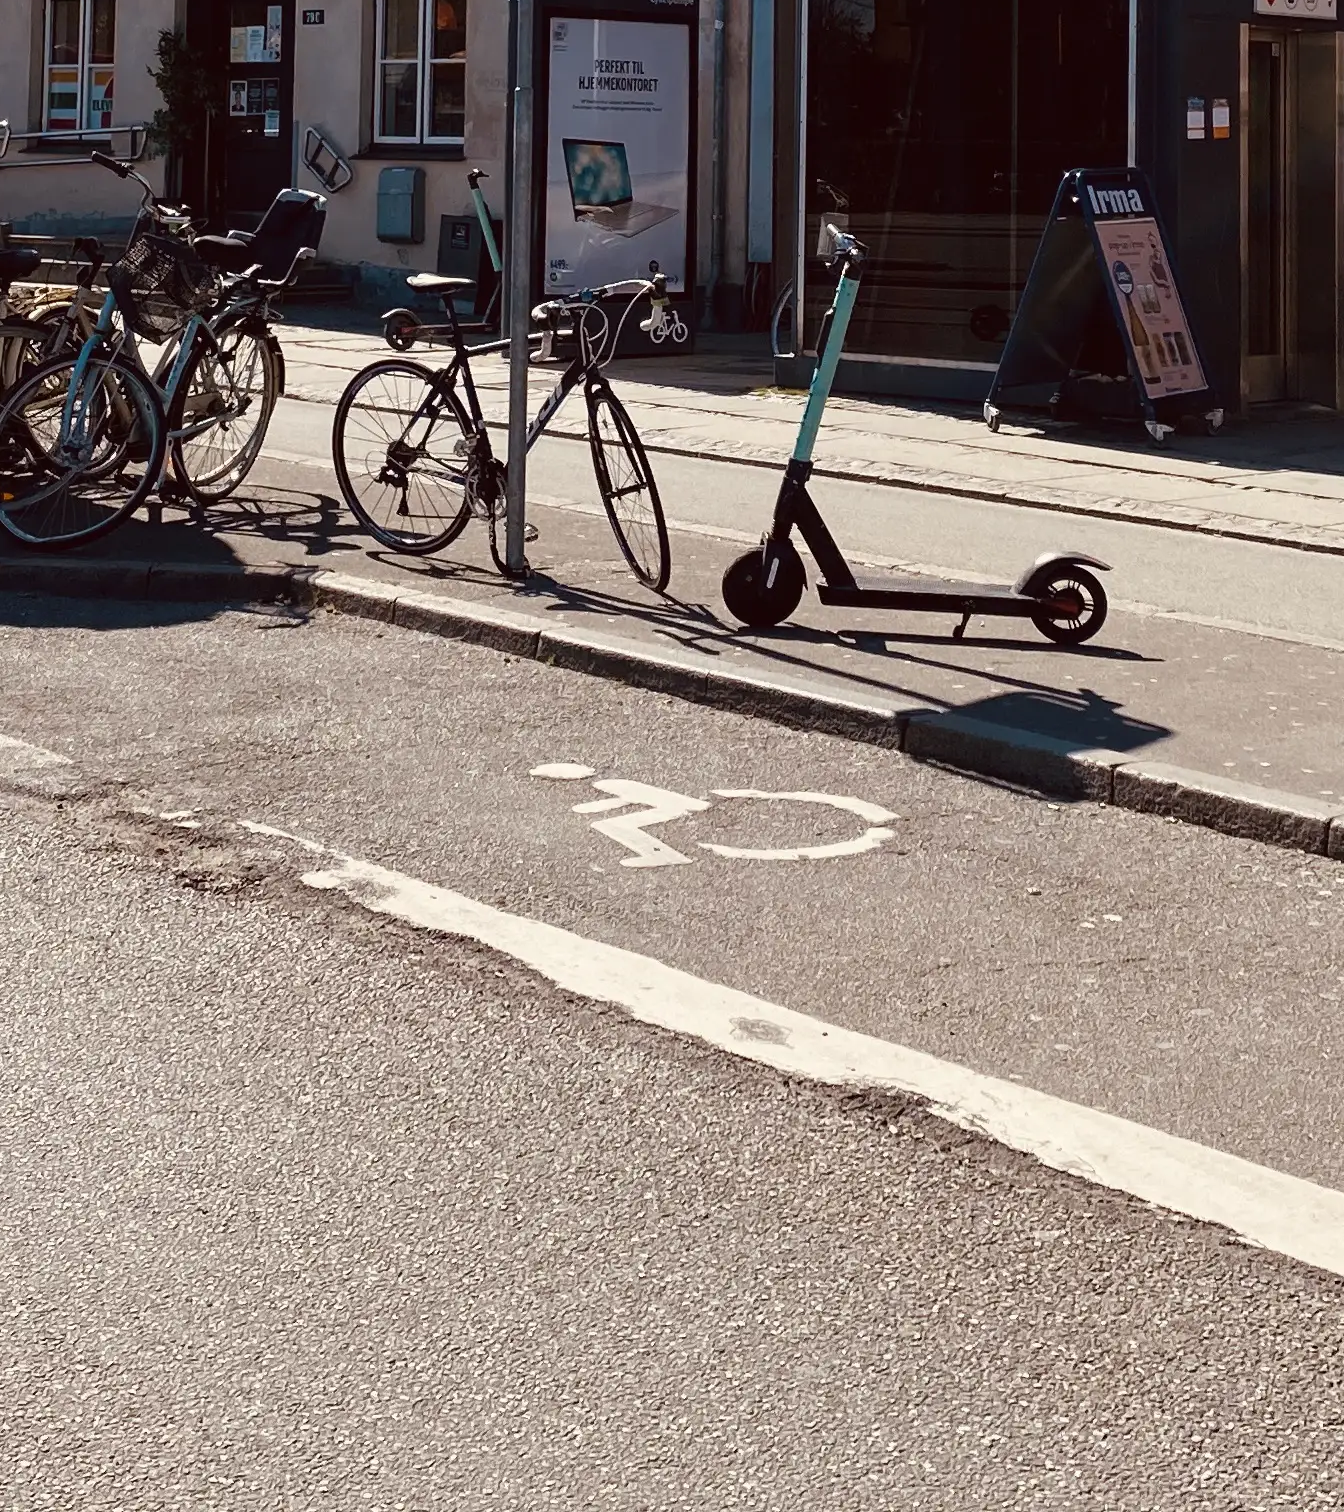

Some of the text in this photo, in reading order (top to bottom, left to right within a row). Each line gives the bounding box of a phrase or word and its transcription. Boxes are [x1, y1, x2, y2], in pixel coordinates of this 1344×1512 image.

[594, 59, 645, 75] PERFEKT TIL
[578, 76, 659, 92] HJEMMEKONTORET
[1087, 184, 1145, 215] Irma
